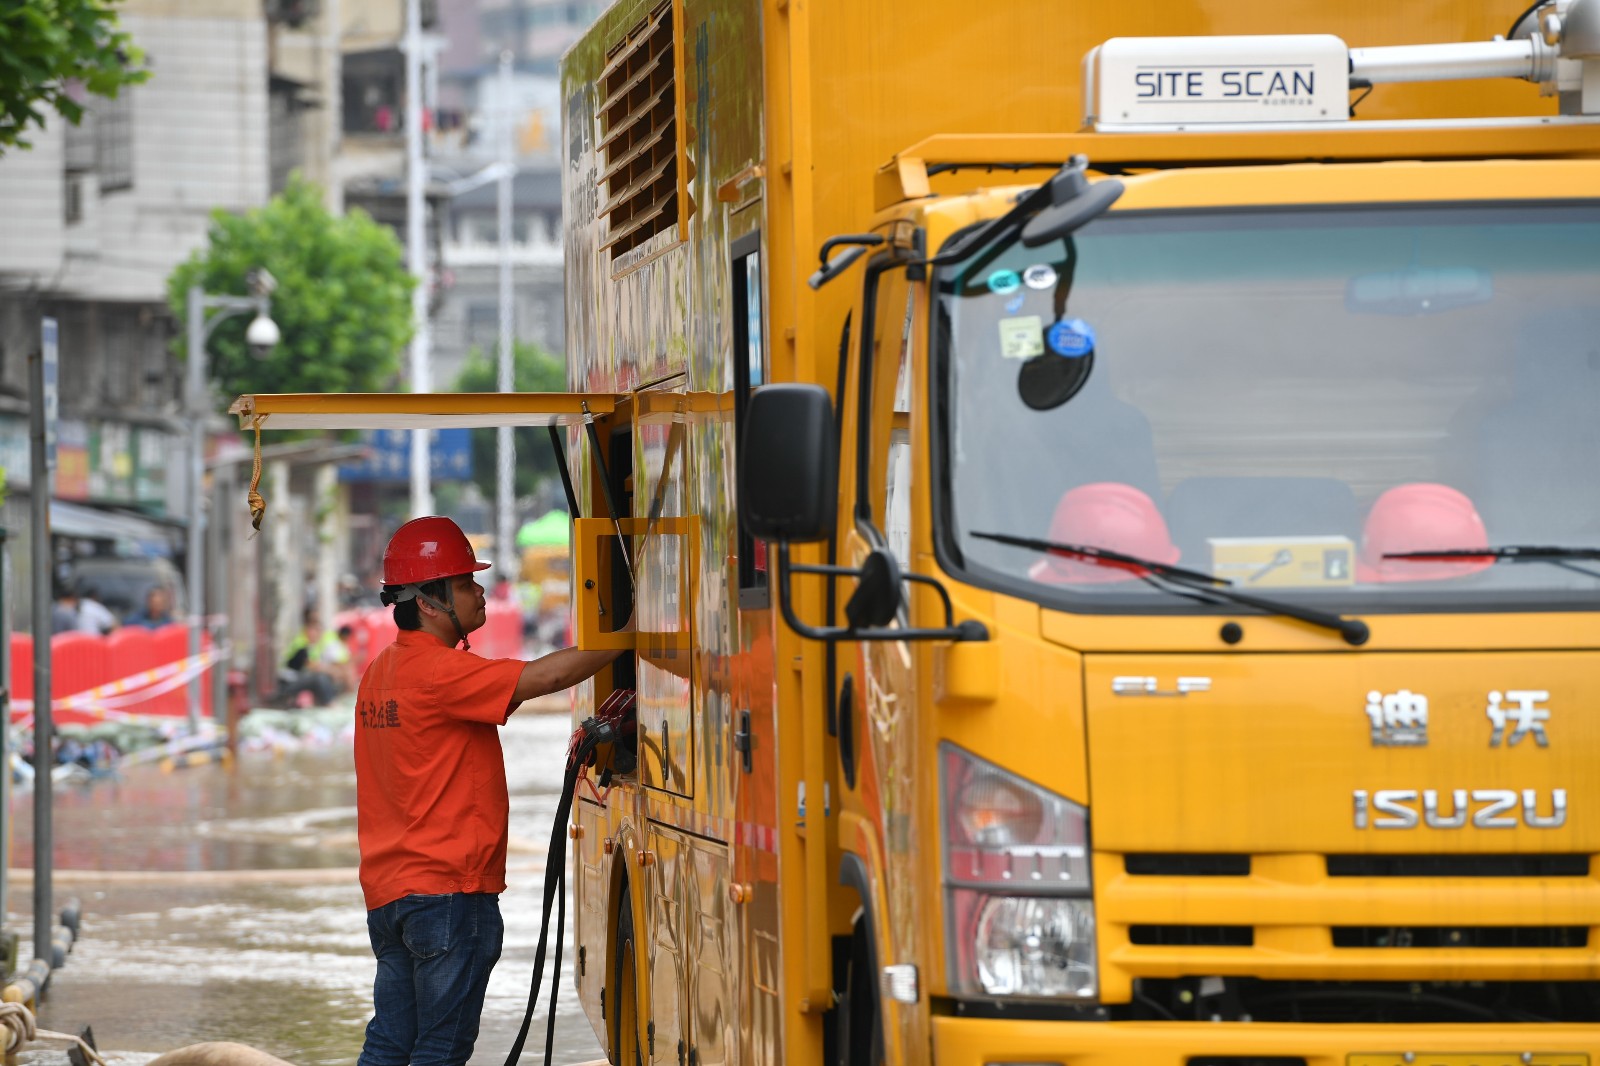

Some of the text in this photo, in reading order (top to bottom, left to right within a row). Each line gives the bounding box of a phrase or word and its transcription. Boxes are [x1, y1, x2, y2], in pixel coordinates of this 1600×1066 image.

[1135, 70, 1315, 97] SITE SCAN
[1353, 789, 1567, 829] ISUZU
